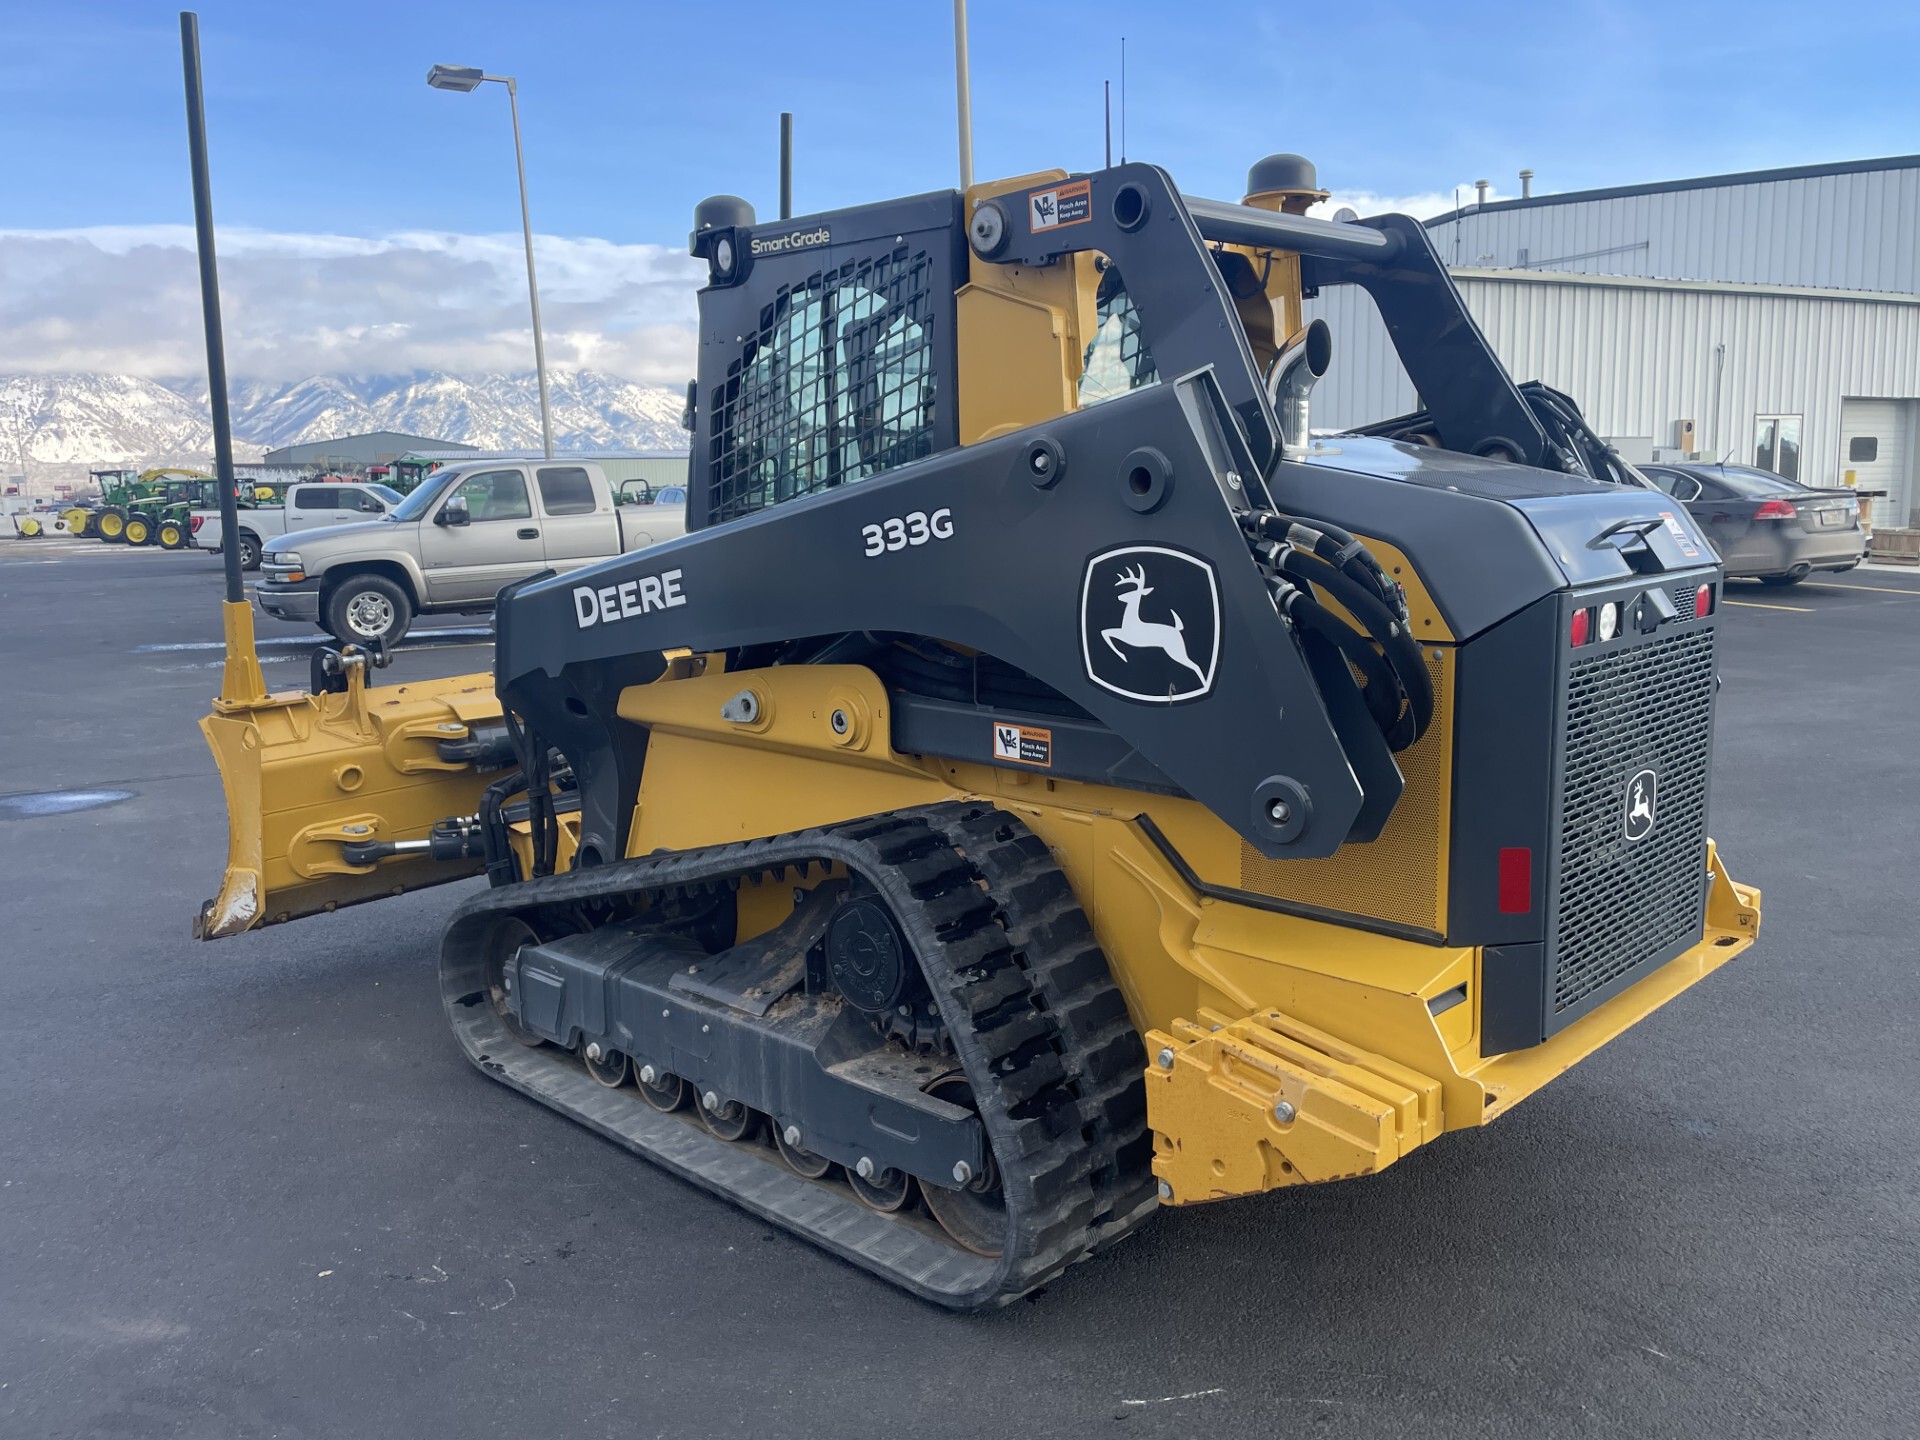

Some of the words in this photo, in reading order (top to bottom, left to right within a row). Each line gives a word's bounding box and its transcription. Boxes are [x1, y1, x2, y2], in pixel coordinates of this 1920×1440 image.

[862, 508, 954, 557] 333G
[573, 568, 687, 628] DEERE
[1032, 752, 1044, 760] Away
[1036, 744, 1048, 752] Area
